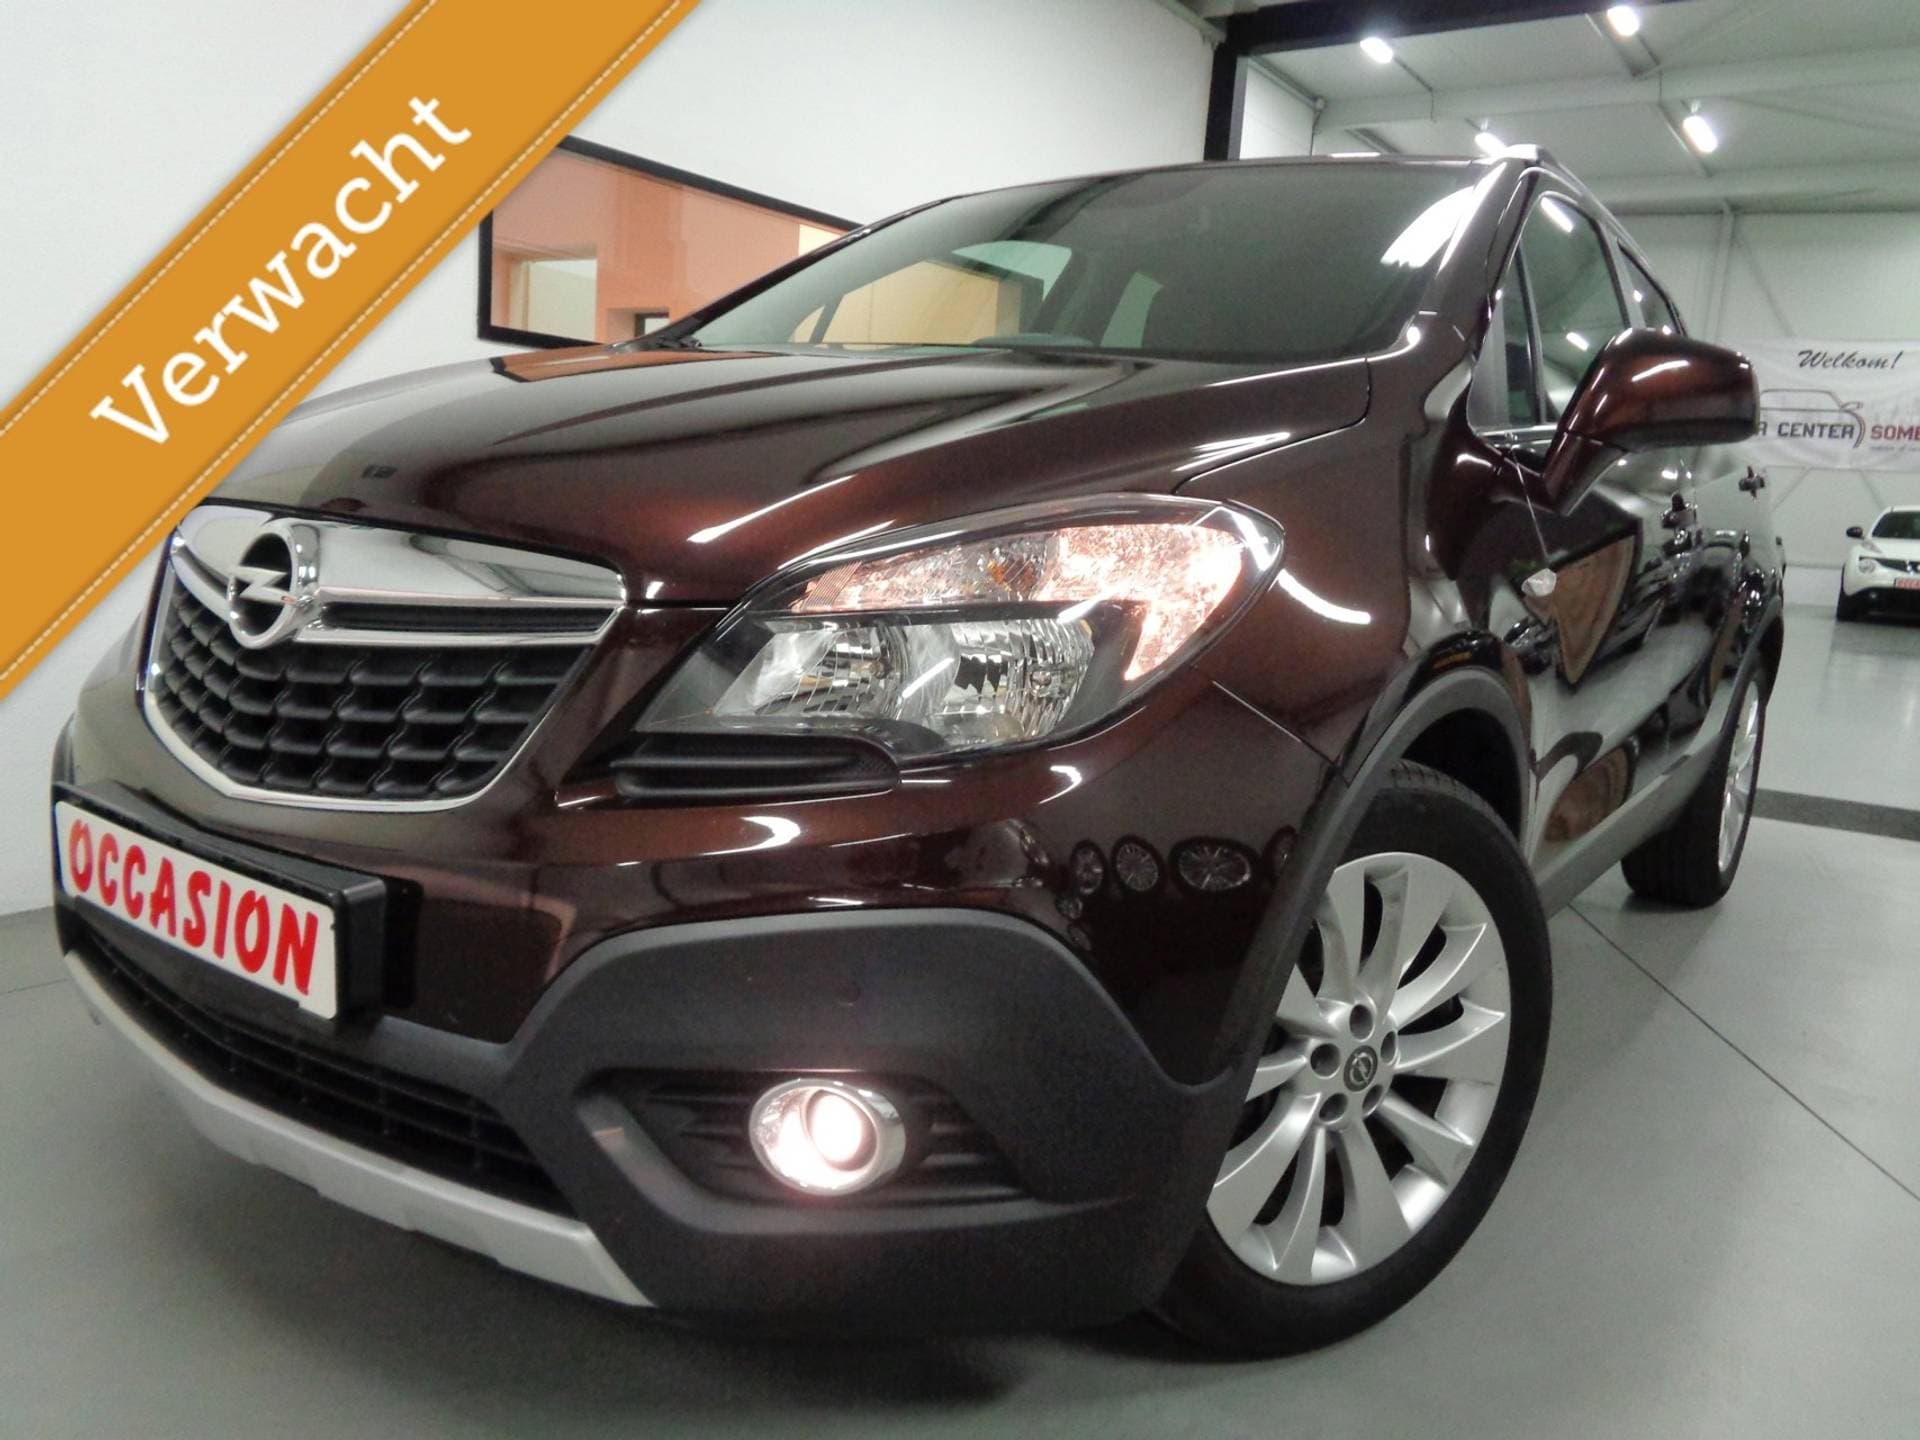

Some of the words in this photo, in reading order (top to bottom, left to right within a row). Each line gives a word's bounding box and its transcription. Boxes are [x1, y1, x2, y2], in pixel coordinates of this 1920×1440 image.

[1798, 350, 1903, 369] Welkom!
[1777, 421, 1855, 439] CENTER
[69, 819, 318, 996] OCCASION
